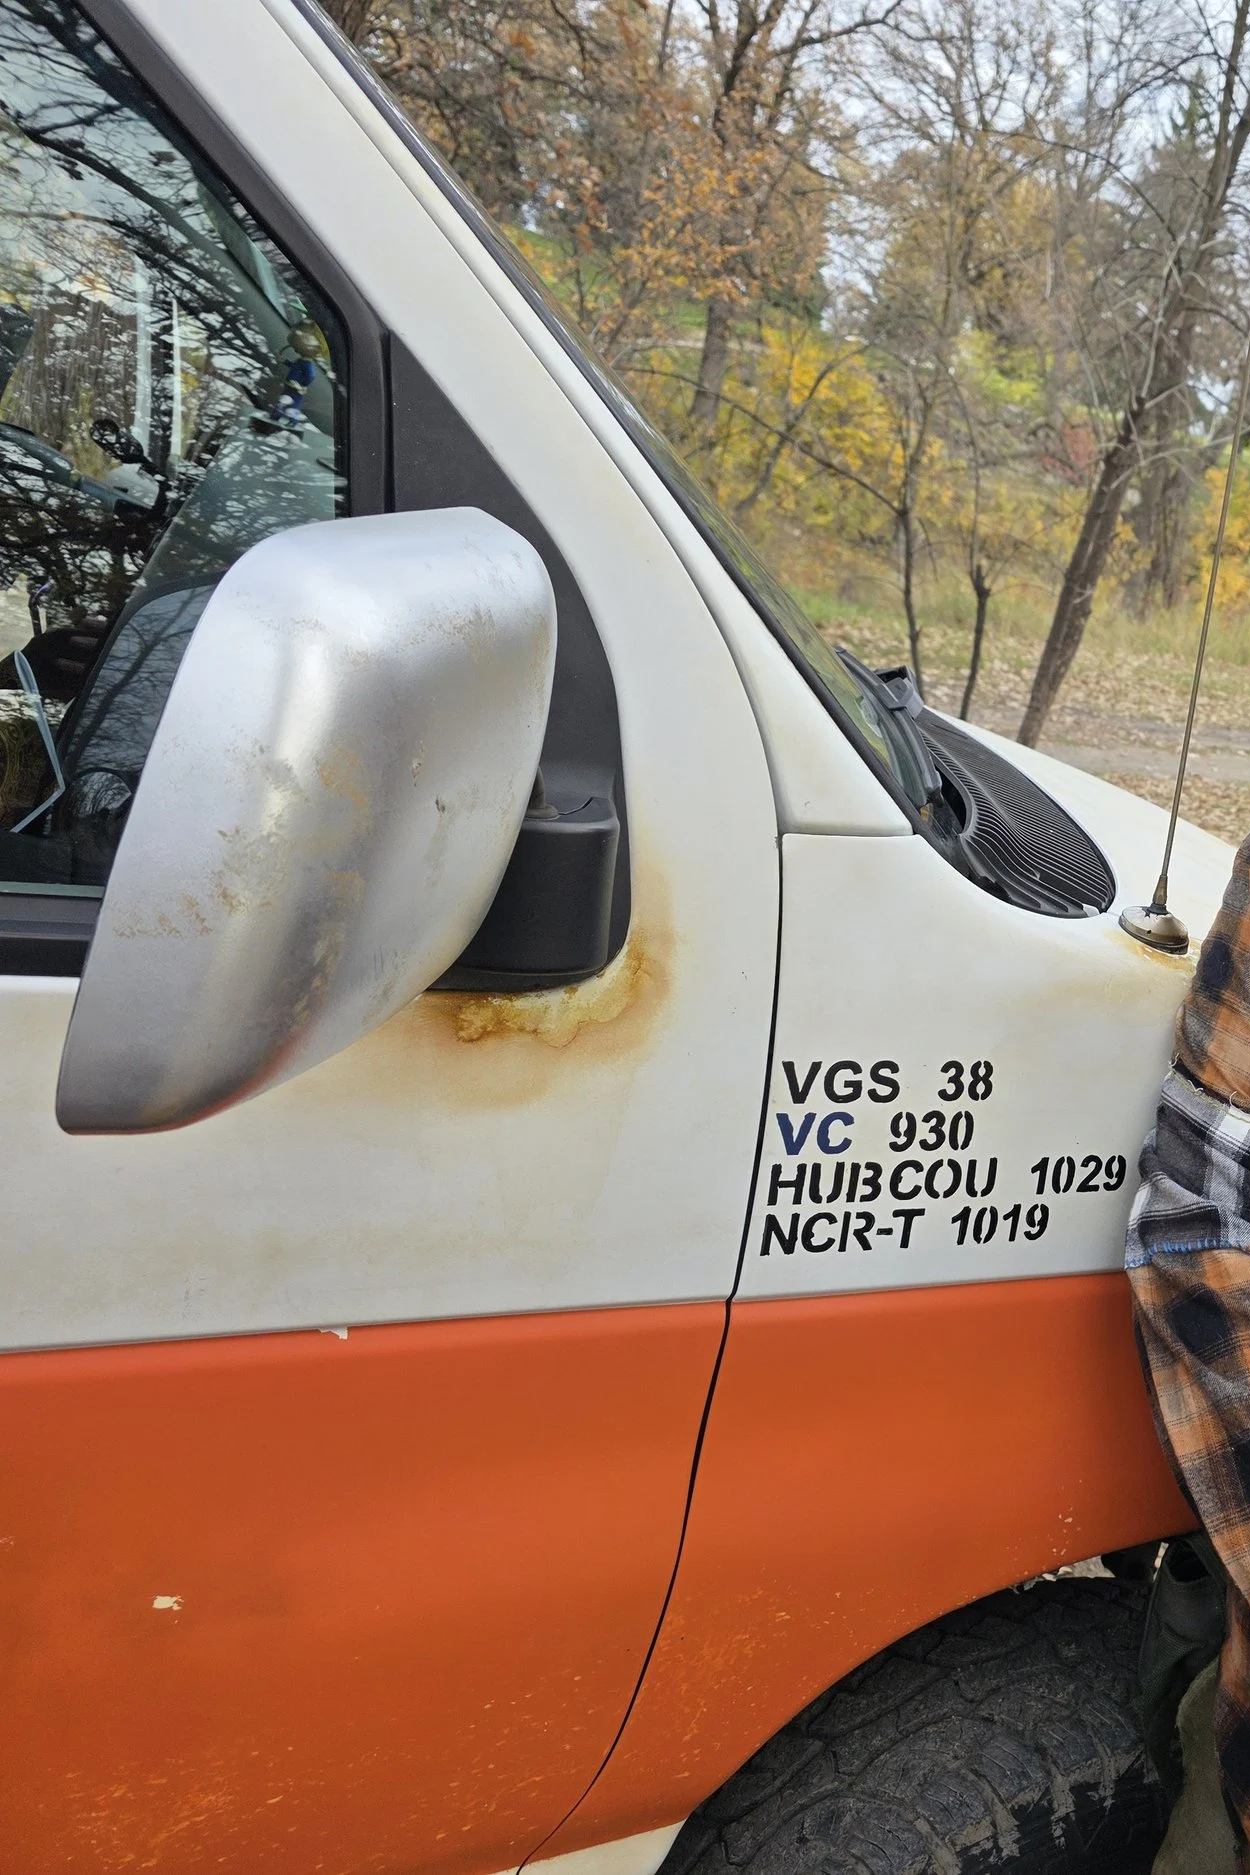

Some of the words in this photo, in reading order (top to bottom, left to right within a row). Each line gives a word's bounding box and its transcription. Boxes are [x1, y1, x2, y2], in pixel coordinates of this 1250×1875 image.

[781, 1060, 901, 1105] VGS
[937, 1060, 994, 1102] 38
[776, 1111, 855, 1156] VC
[888, 1110, 975, 1153] 930
[767, 1156, 998, 1206] HUBCOU
[1030, 1154, 1127, 1195] 1029
[759, 1207, 926, 1257] NCR-T
[951, 1203, 1050, 1246] 1019
